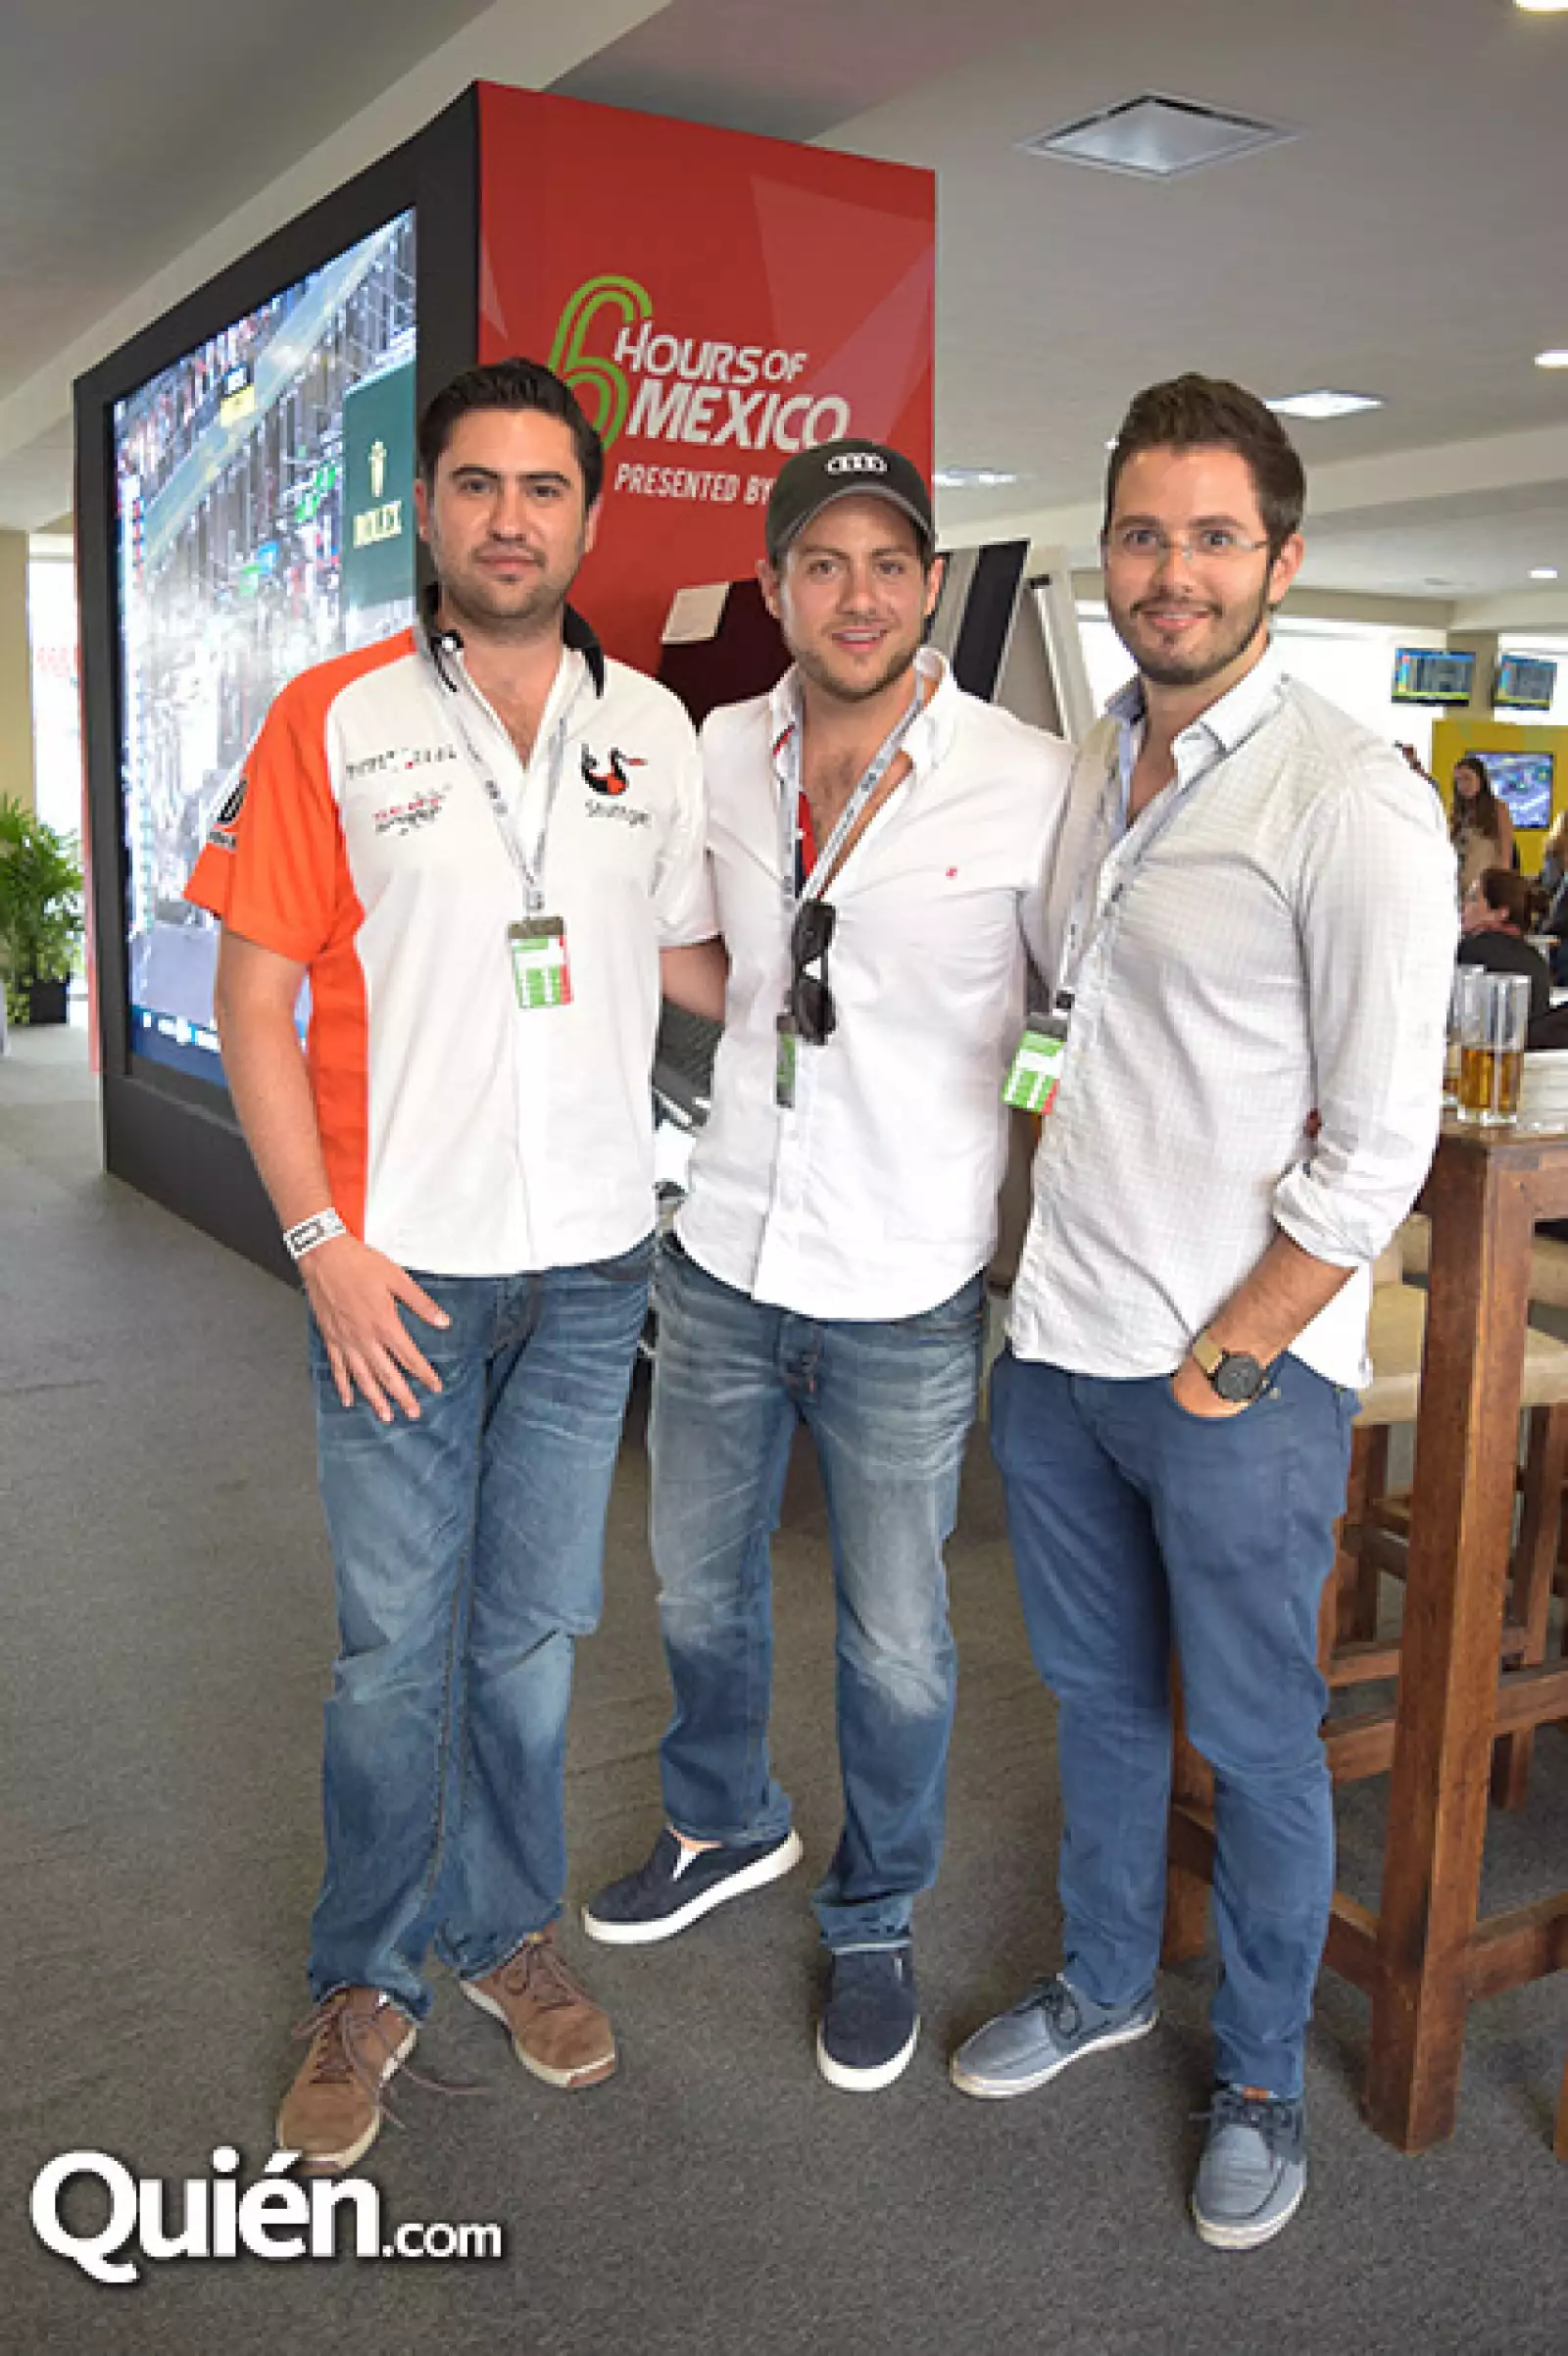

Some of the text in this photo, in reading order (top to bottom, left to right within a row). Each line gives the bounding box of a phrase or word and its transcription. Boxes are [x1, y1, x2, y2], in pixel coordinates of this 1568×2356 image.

[549, 275, 808, 451] 6 HOURS OF
[625, 378, 851, 453] MEXICO
[613, 463, 777, 505] PRESENTED BY
